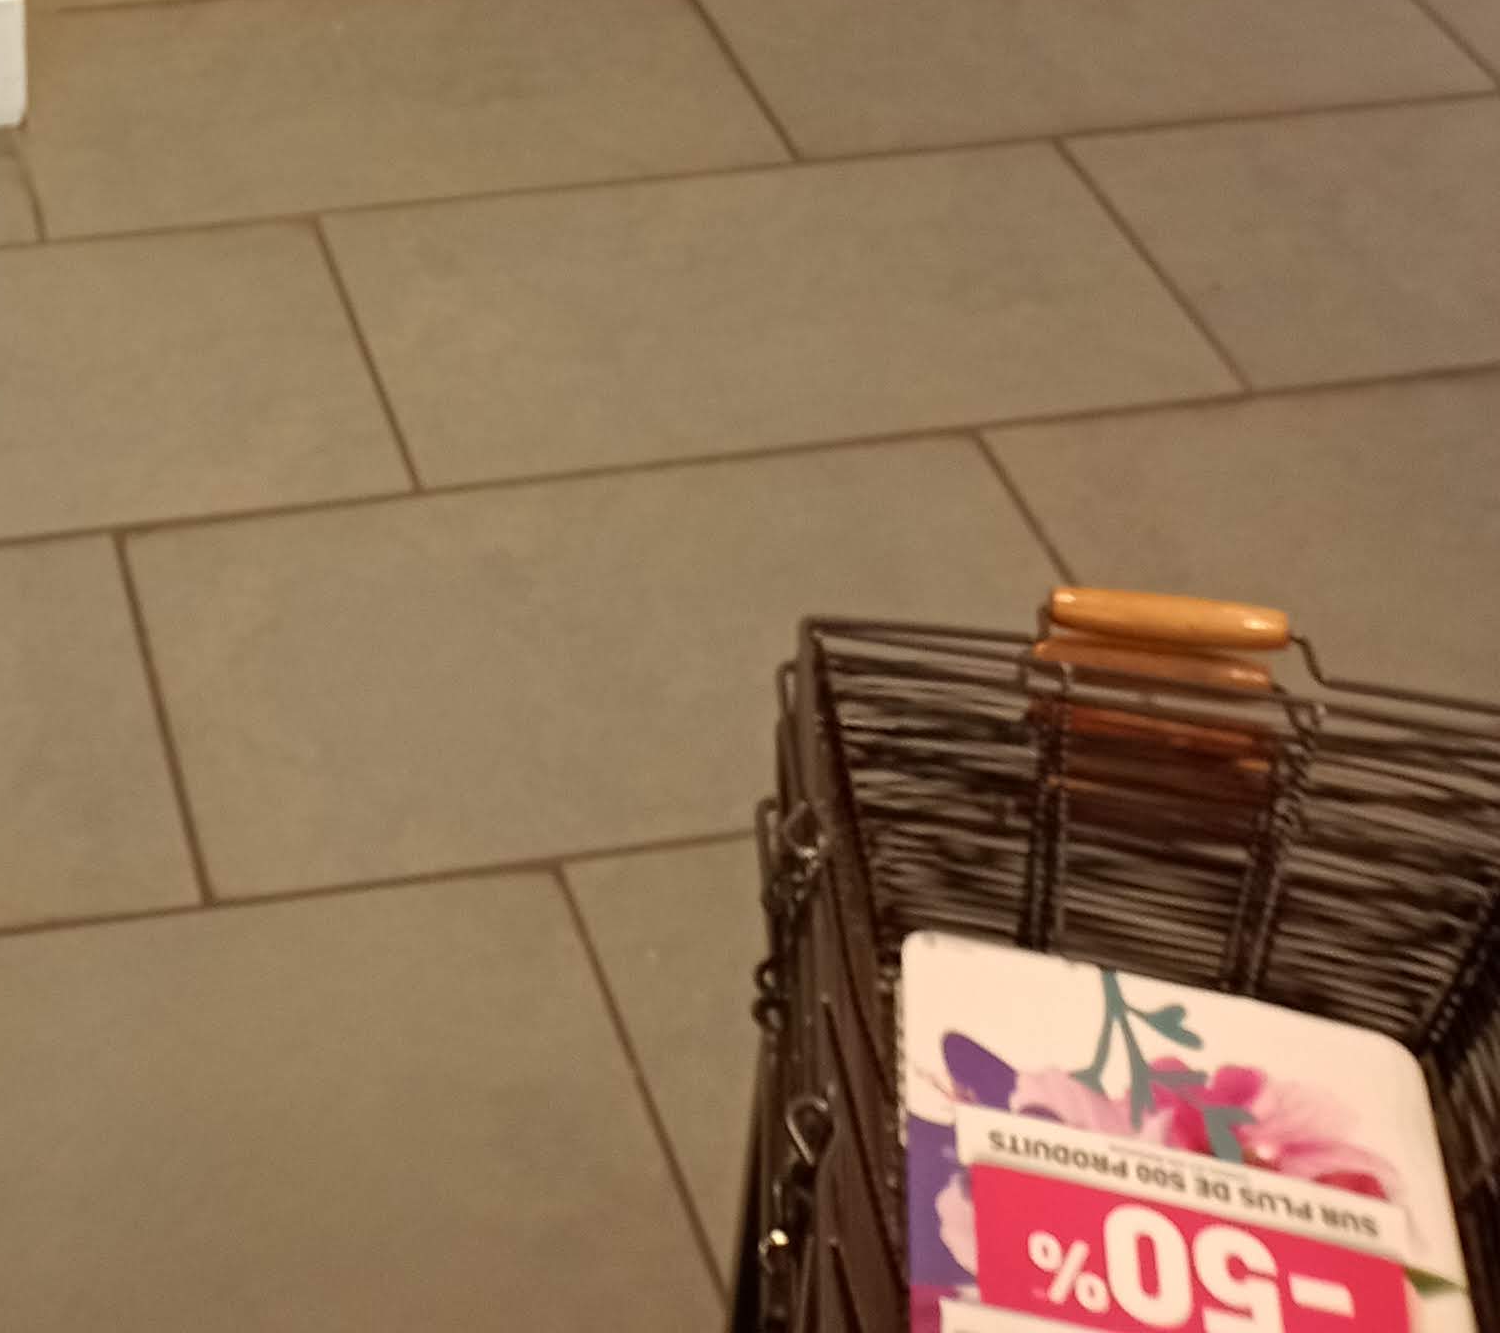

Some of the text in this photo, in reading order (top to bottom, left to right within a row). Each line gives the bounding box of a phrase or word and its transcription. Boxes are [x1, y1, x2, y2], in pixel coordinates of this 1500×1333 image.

[987, 1129, 1129, 1181] PRODUITS
[1136, 1161, 1187, 1194] 500
[1198, 1176, 1230, 1203] DE
[1243, 1185, 1315, 1222] PLUS
[1320, 1203, 1380, 1238] SUR
[1028, 1204, 1355, 1333] -50%
